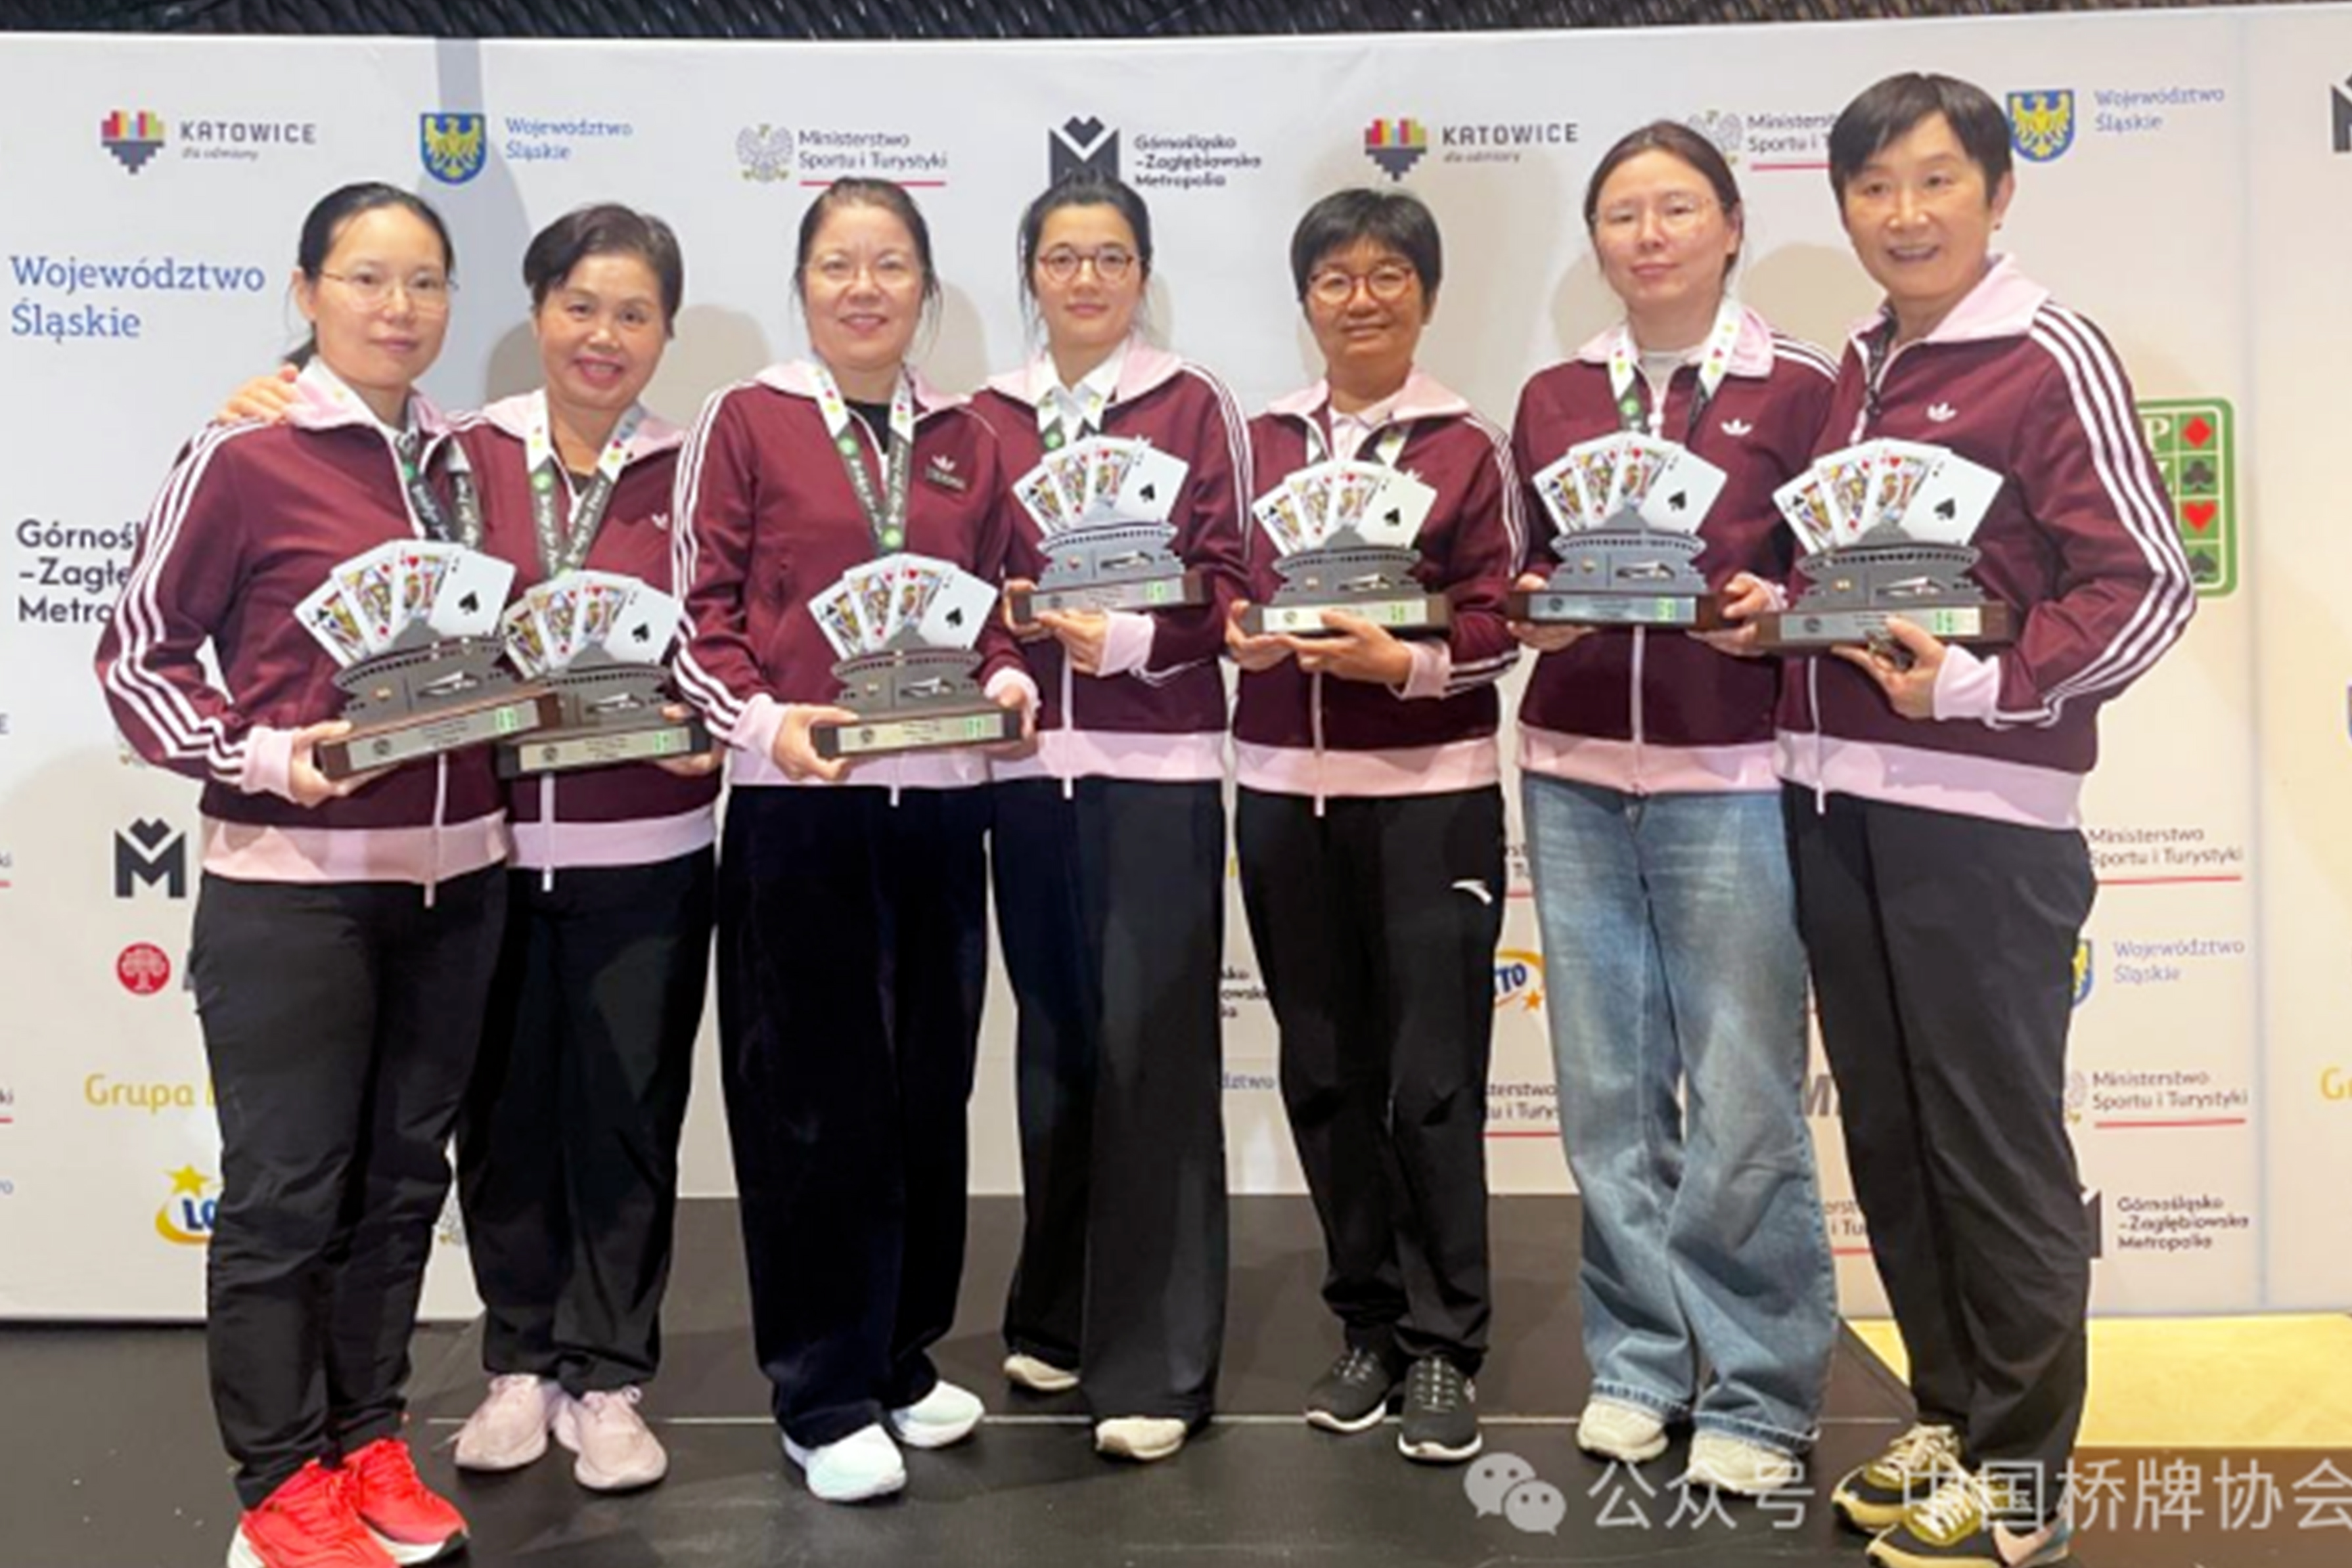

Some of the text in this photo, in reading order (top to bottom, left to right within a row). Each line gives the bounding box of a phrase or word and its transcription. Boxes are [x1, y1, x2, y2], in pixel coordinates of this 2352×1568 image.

[2094, 87, 2225, 108] Województwo
[181, 121, 315, 144] KATOWICE
[505, 117, 633, 137] Województwo
[2095, 113, 2162, 133] Śląskie
[799, 129, 911, 148] Ministerstwo
[1443, 123, 1577, 146] KATOWICE
[505, 140, 571, 160] Śląskie
[1748, 136, 1807, 154] Sportu
[799, 151, 857, 171] Sportu
[871, 150, 948, 170] Turystyki
[1135, 172, 1227, 189] Metropolia
[10, 256, 265, 294] Województwo
[12, 299, 141, 344] Śląskie
[2163, 846, 2244, 865] Turystyki
[2092, 1071, 2209, 1086] Ministerstwo
[84, 1073, 194, 1115] Grupa
[2092, 1093, 2152, 1111] Sportu
[2167, 1090, 2248, 1108] Turystyki
[2118, 1235, 2213, 1253] Metropolia
